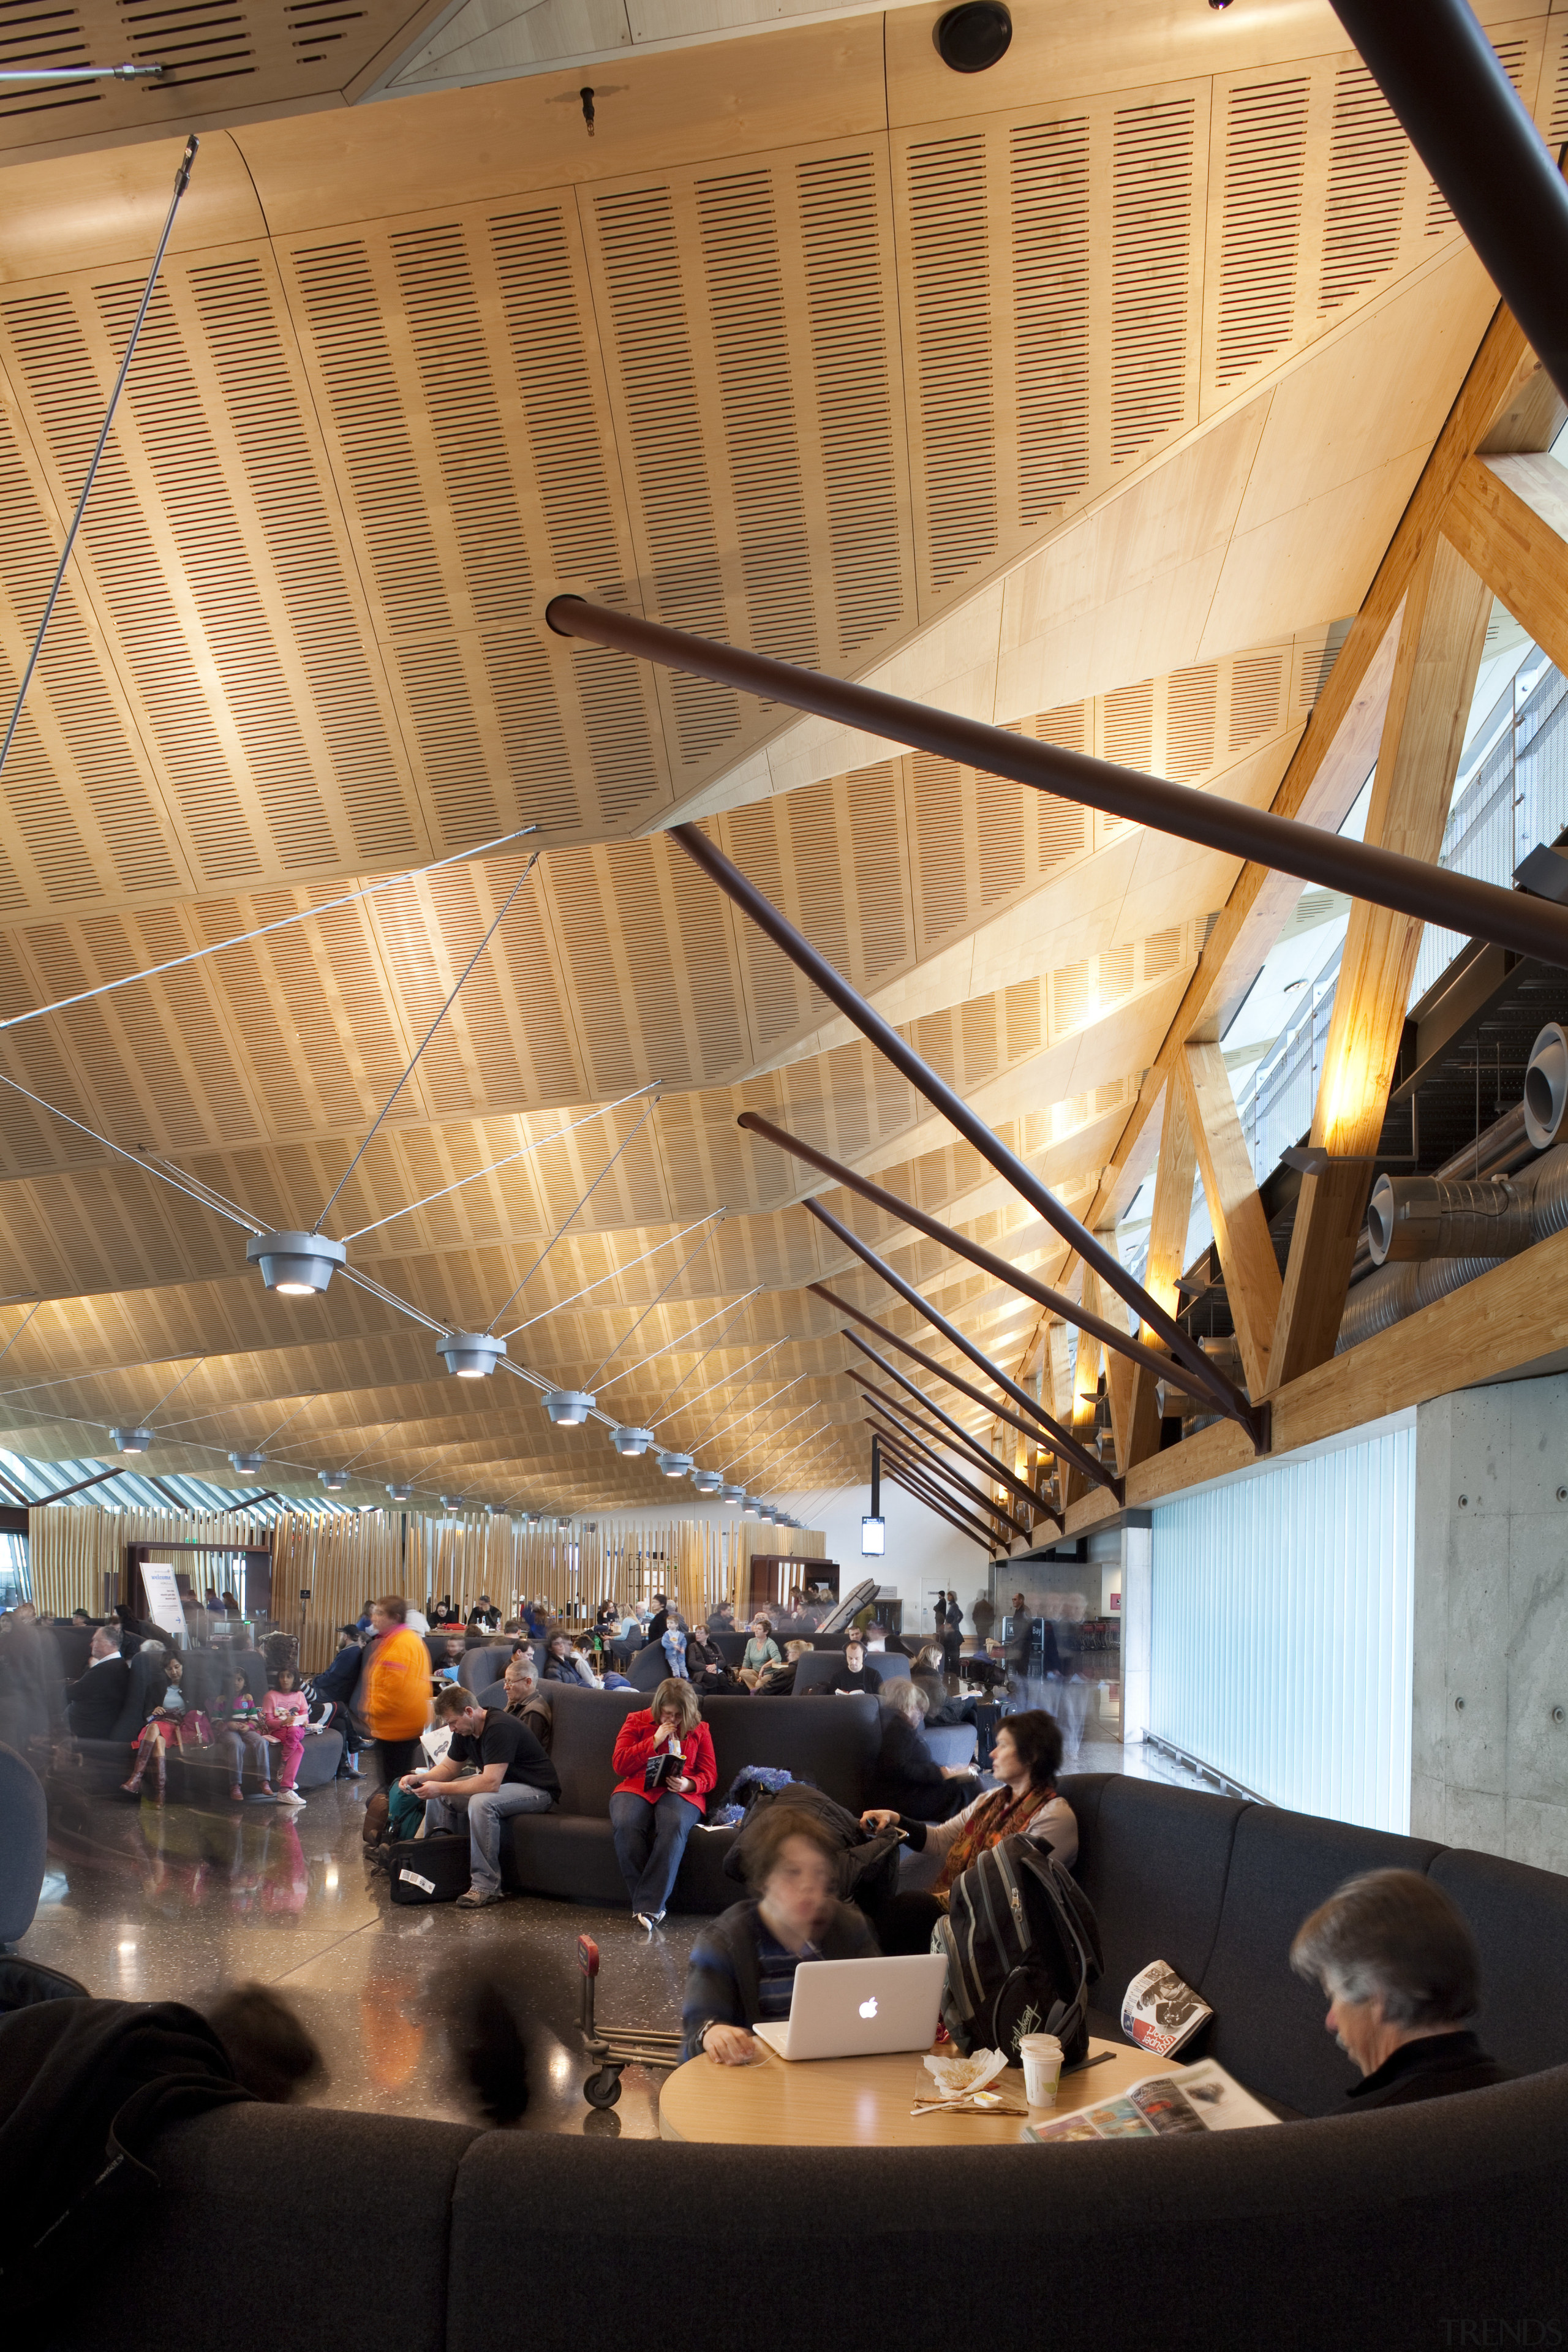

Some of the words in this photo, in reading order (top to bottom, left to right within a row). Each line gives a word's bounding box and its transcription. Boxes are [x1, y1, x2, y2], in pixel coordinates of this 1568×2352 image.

[1032, 1626, 1042, 1637] Bay
[1142, 2035, 1167, 2053] Super
[1146, 2026, 1174, 2046] Sport
